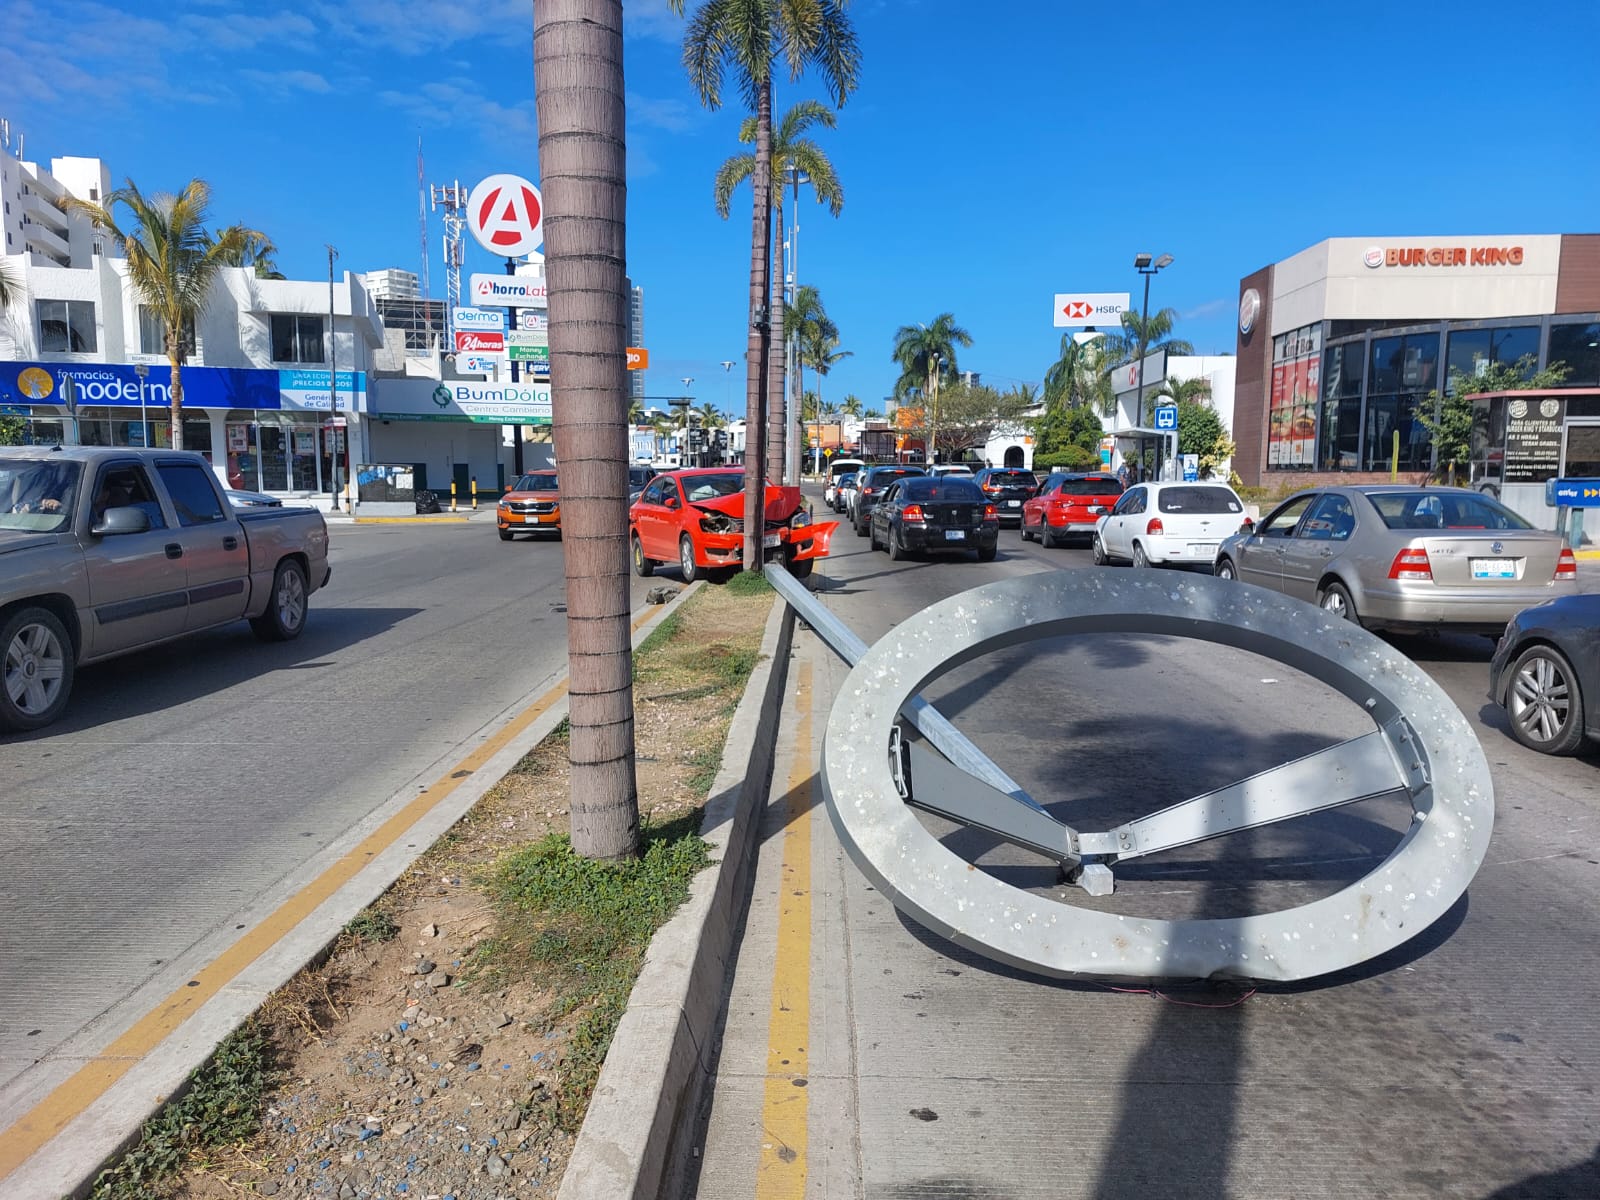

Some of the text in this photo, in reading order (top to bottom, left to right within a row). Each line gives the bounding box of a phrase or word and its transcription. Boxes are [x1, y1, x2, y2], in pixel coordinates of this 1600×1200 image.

[1385, 248, 1467, 266] BURGER
[1471, 247, 1523, 265] KING
[1095, 305, 1122, 314] HSBC
[457, 311, 499, 322] derma
[520, 347, 543, 355] Money
[465, 405, 550, 414] Centro Cambiario
